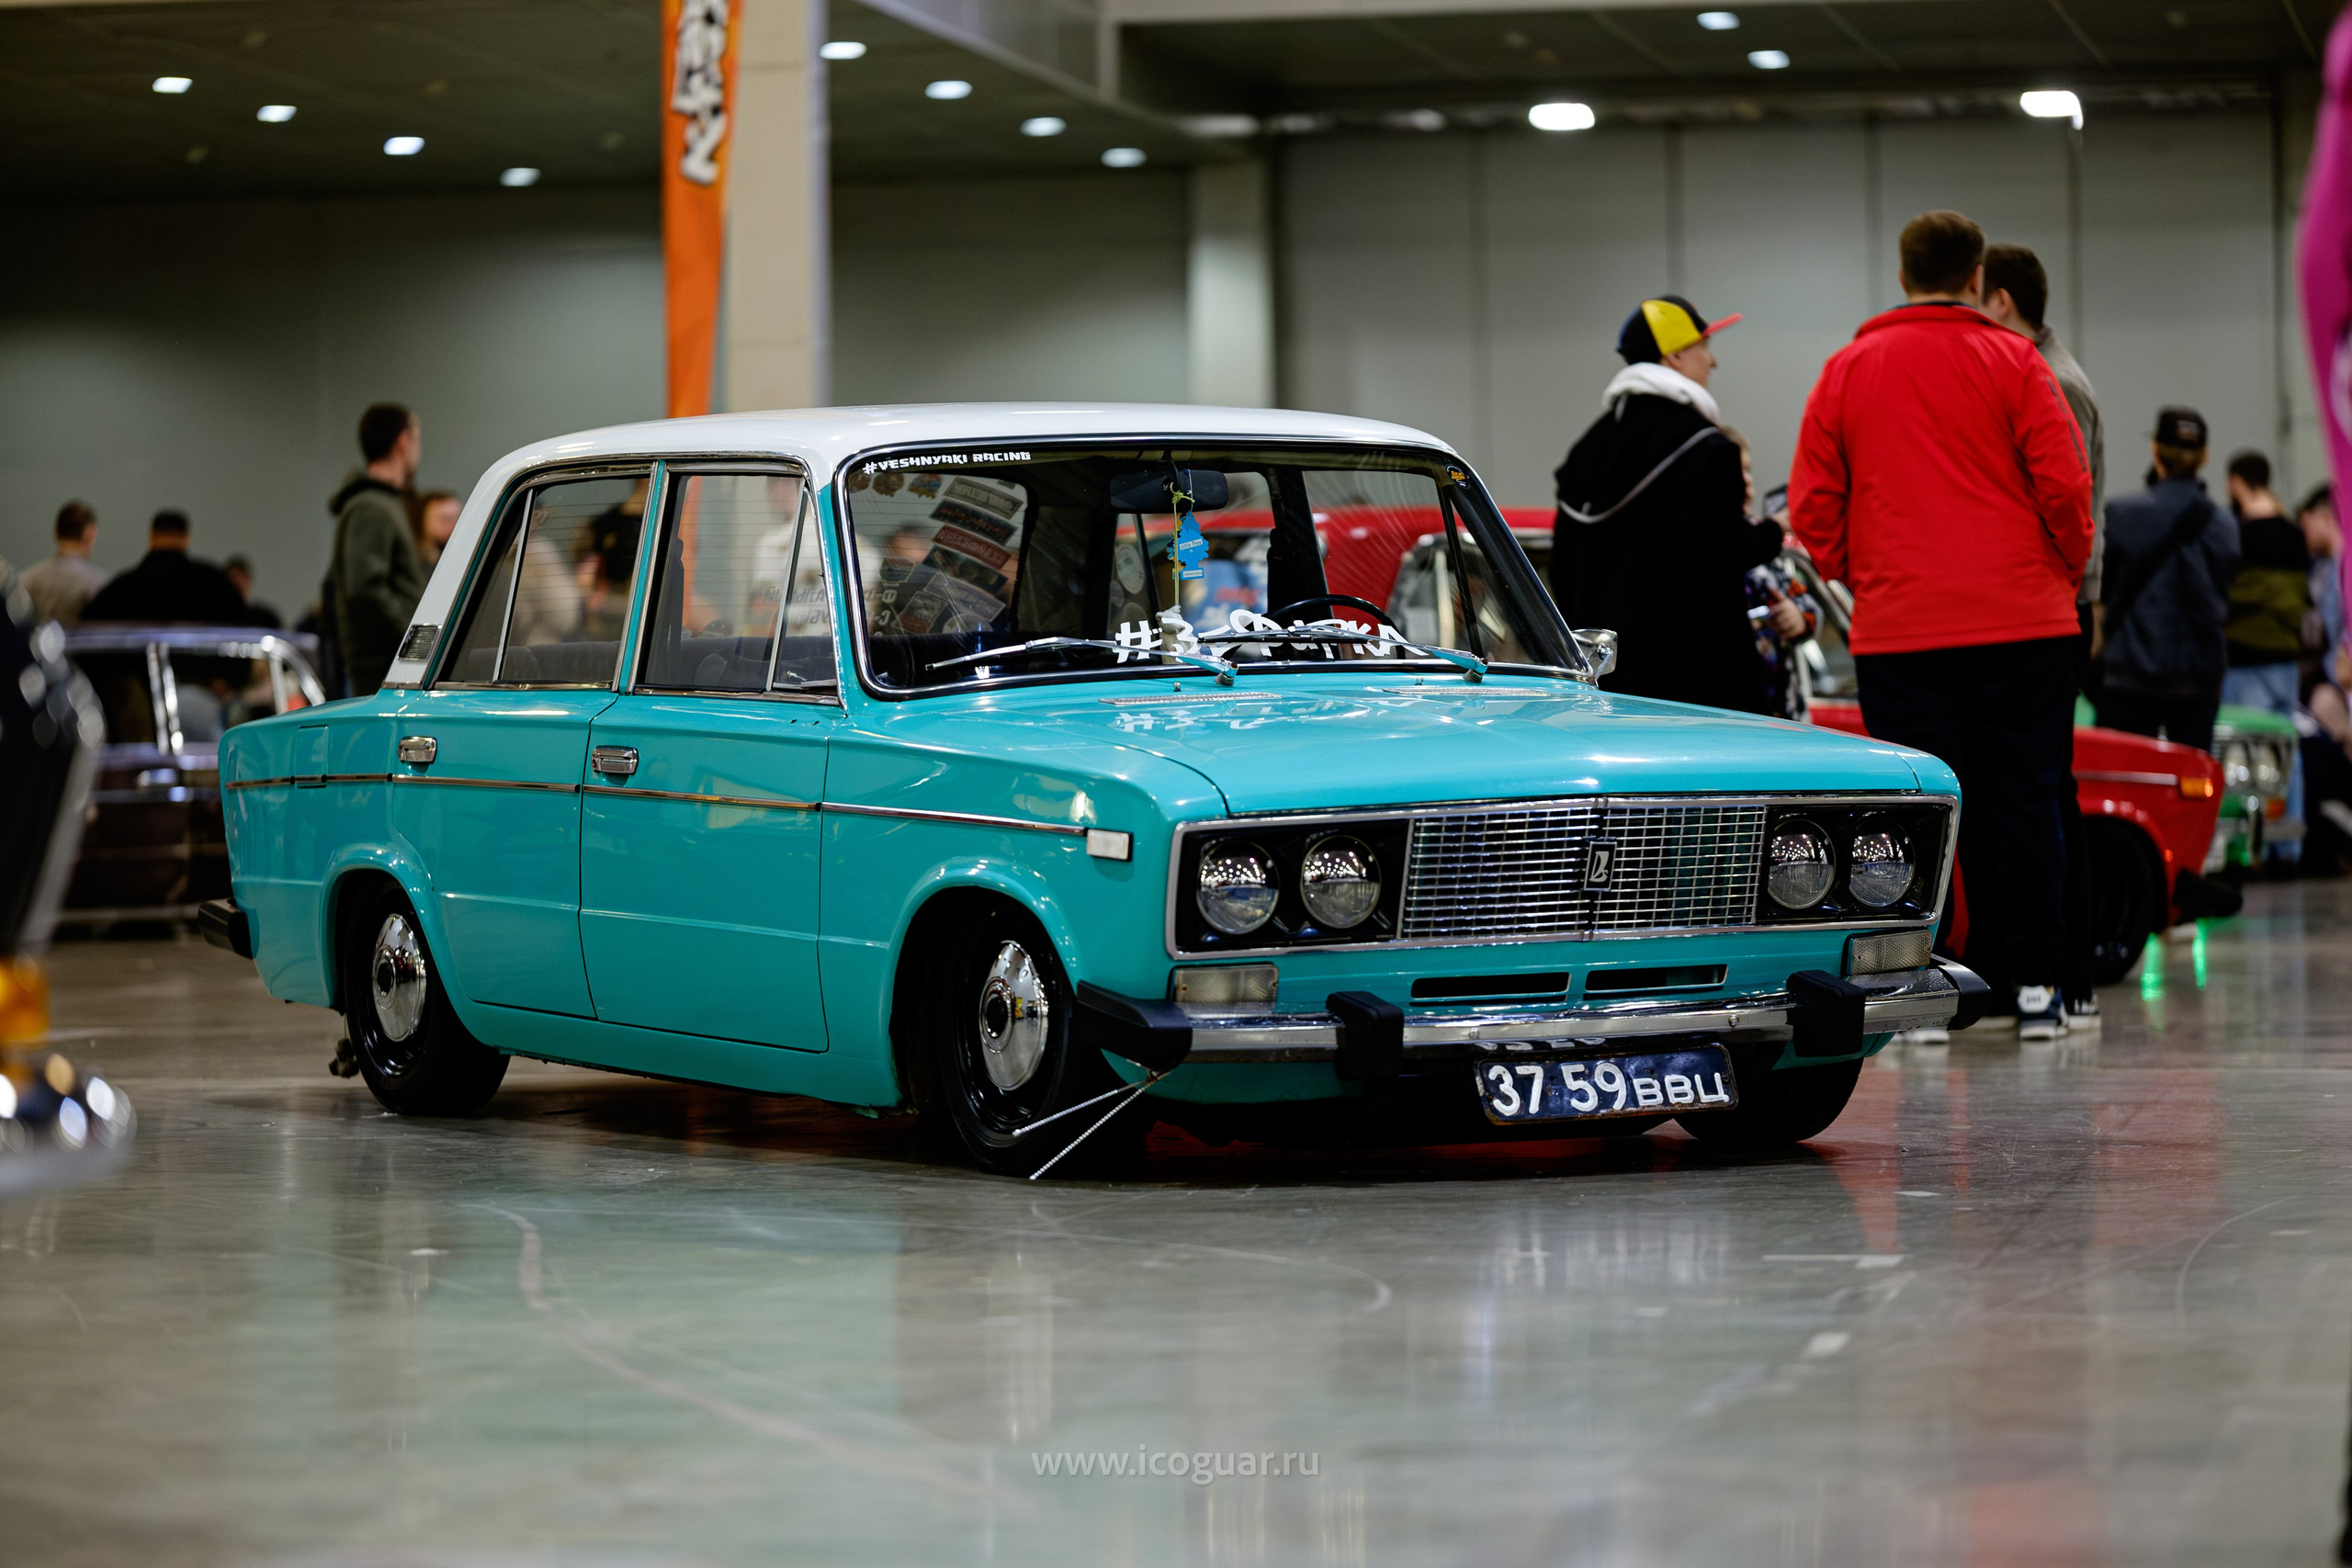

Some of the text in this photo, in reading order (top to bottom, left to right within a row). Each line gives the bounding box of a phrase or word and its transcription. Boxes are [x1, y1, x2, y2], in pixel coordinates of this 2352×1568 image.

[862, 451, 1031, 475] #VESHNYAKI RACING
[1488, 1065, 1544, 1116] 37
